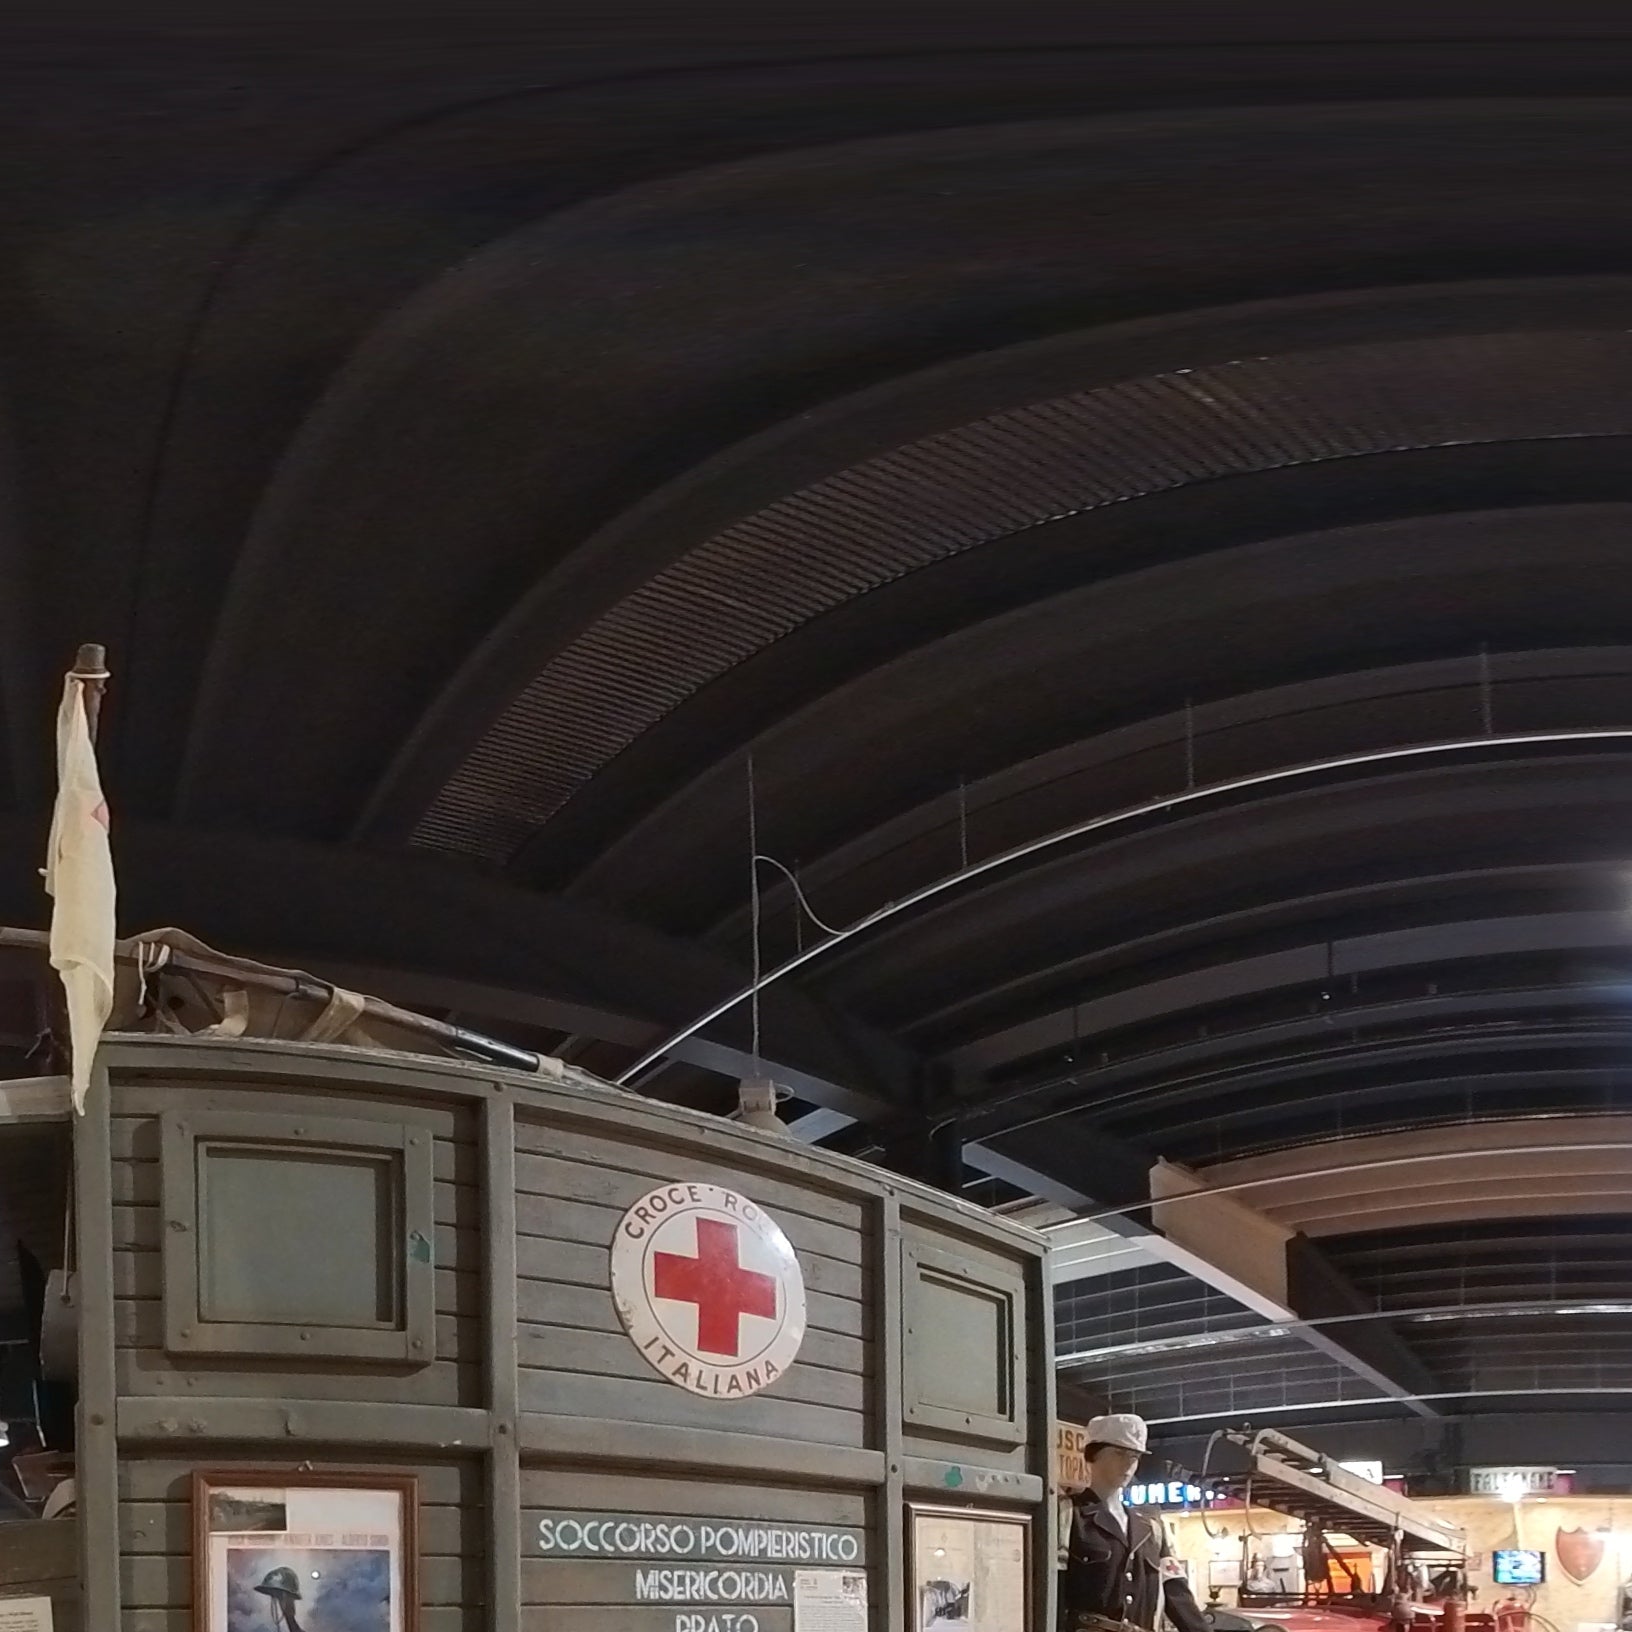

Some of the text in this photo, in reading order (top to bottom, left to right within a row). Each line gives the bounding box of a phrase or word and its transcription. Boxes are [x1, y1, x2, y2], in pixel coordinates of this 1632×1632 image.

[624, 1185, 702, 1240] CROCE
[643, 1336, 779, 1395] ITALIANA
[539, 1519, 858, 1560] SOCCORSO POMPIERISTICO
[636, 1569, 789, 1600] MISERICORDIA
